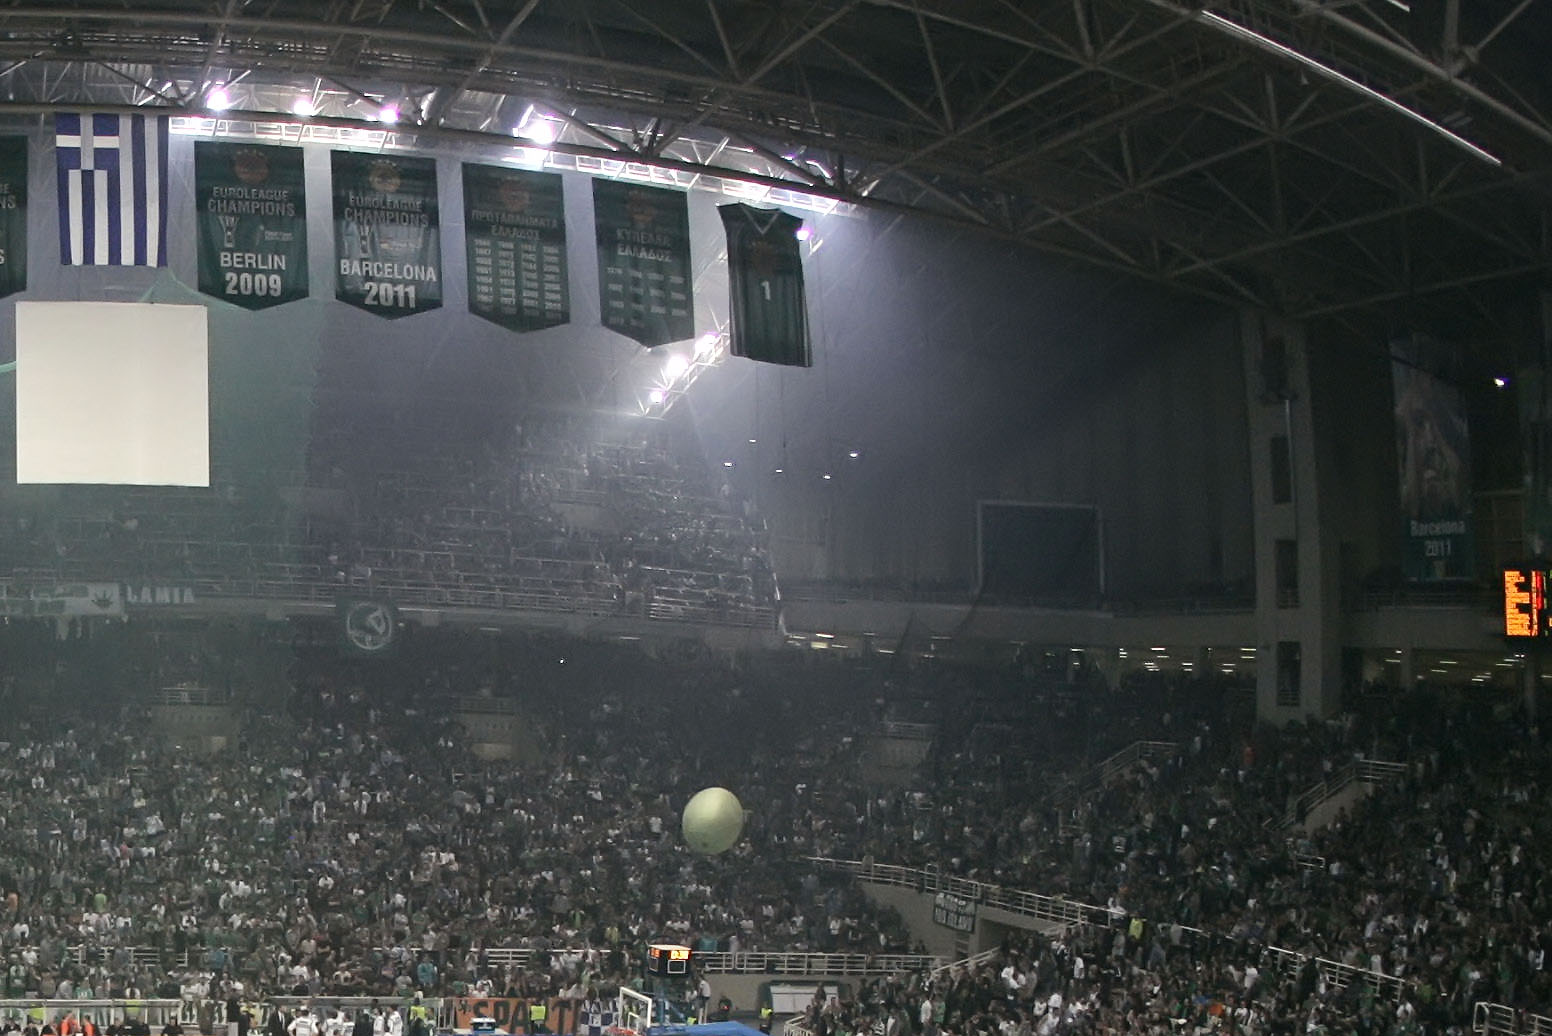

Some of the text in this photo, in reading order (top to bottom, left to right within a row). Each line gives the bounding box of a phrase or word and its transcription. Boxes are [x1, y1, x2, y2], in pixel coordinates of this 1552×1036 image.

[208, 199, 295, 217] CHAMPIONS
[220, 251, 286, 270] BERLIN
[341, 259, 436, 281] BARCELONA
[225, 272, 282, 297] 2009
[760, 280, 771, 301] 1
[364, 282, 415, 309] 2011
